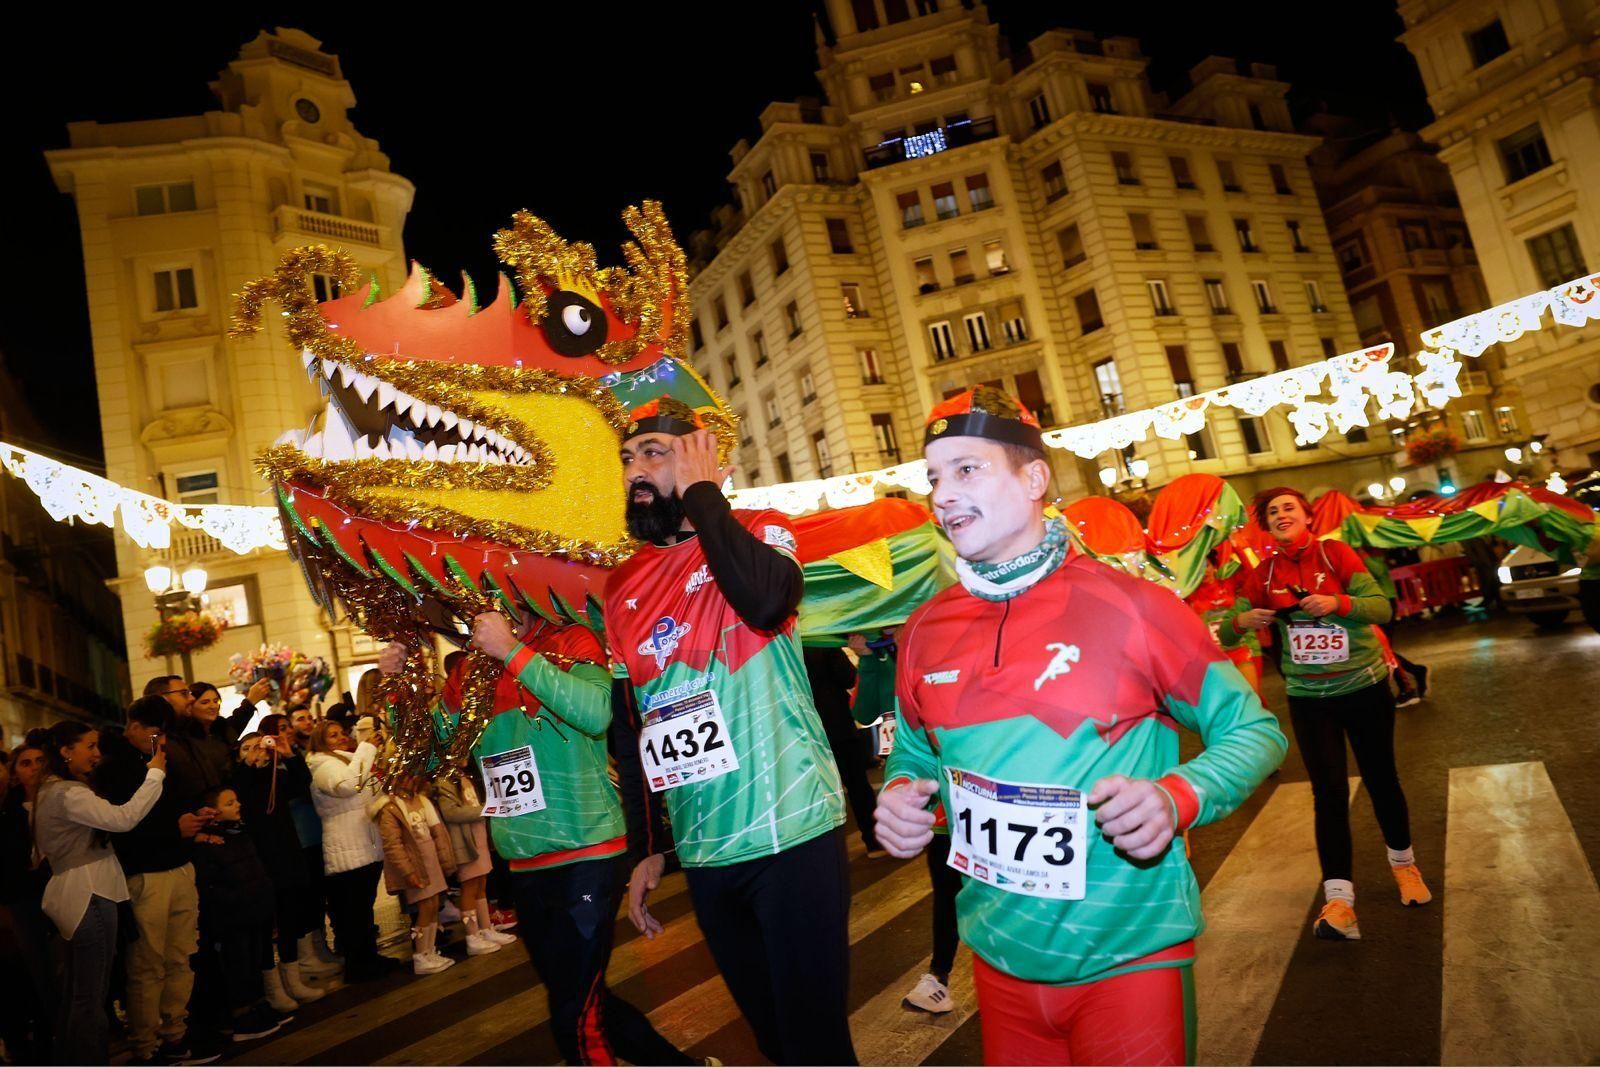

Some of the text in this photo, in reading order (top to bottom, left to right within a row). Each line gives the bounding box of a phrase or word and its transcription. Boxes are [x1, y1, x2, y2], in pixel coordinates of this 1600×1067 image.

[1293, 634, 1344, 650] 1235
[645, 720, 725, 766] 1432
[963, 780, 998, 801] NOCTURNA
[959, 807, 1075, 866] 1173
